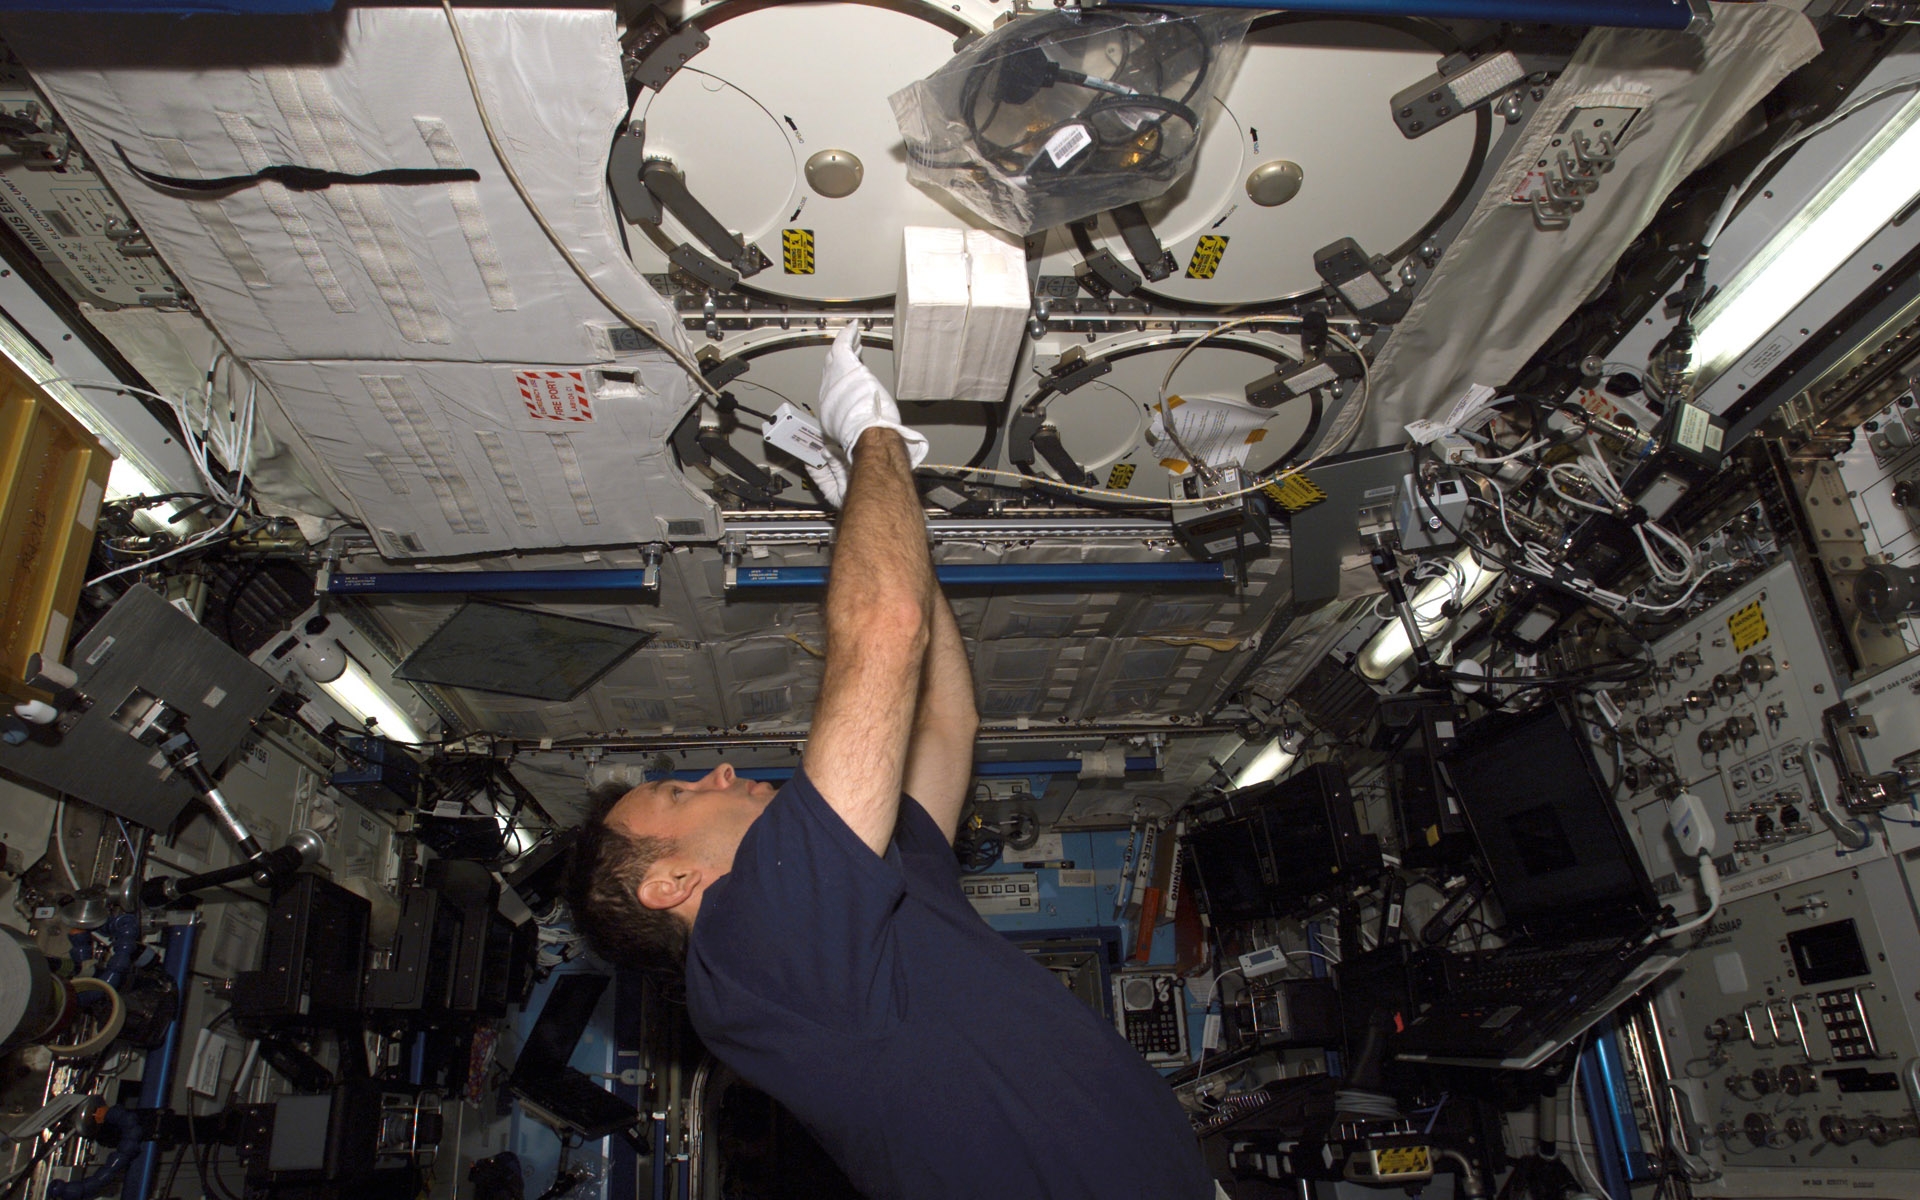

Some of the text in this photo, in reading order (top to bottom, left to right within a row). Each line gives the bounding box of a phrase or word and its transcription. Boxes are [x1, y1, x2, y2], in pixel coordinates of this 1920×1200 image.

[9, 216, 49, 252] MINUS
[18, 196, 61, 241] ELECTRONIC
[546, 380, 565, 416] FIRE PORT
[1887, 680, 1899, 690] GAS
[1171, 849, 1184, 901] WARNING
[1707, 918, 1742, 937] GASMAP
